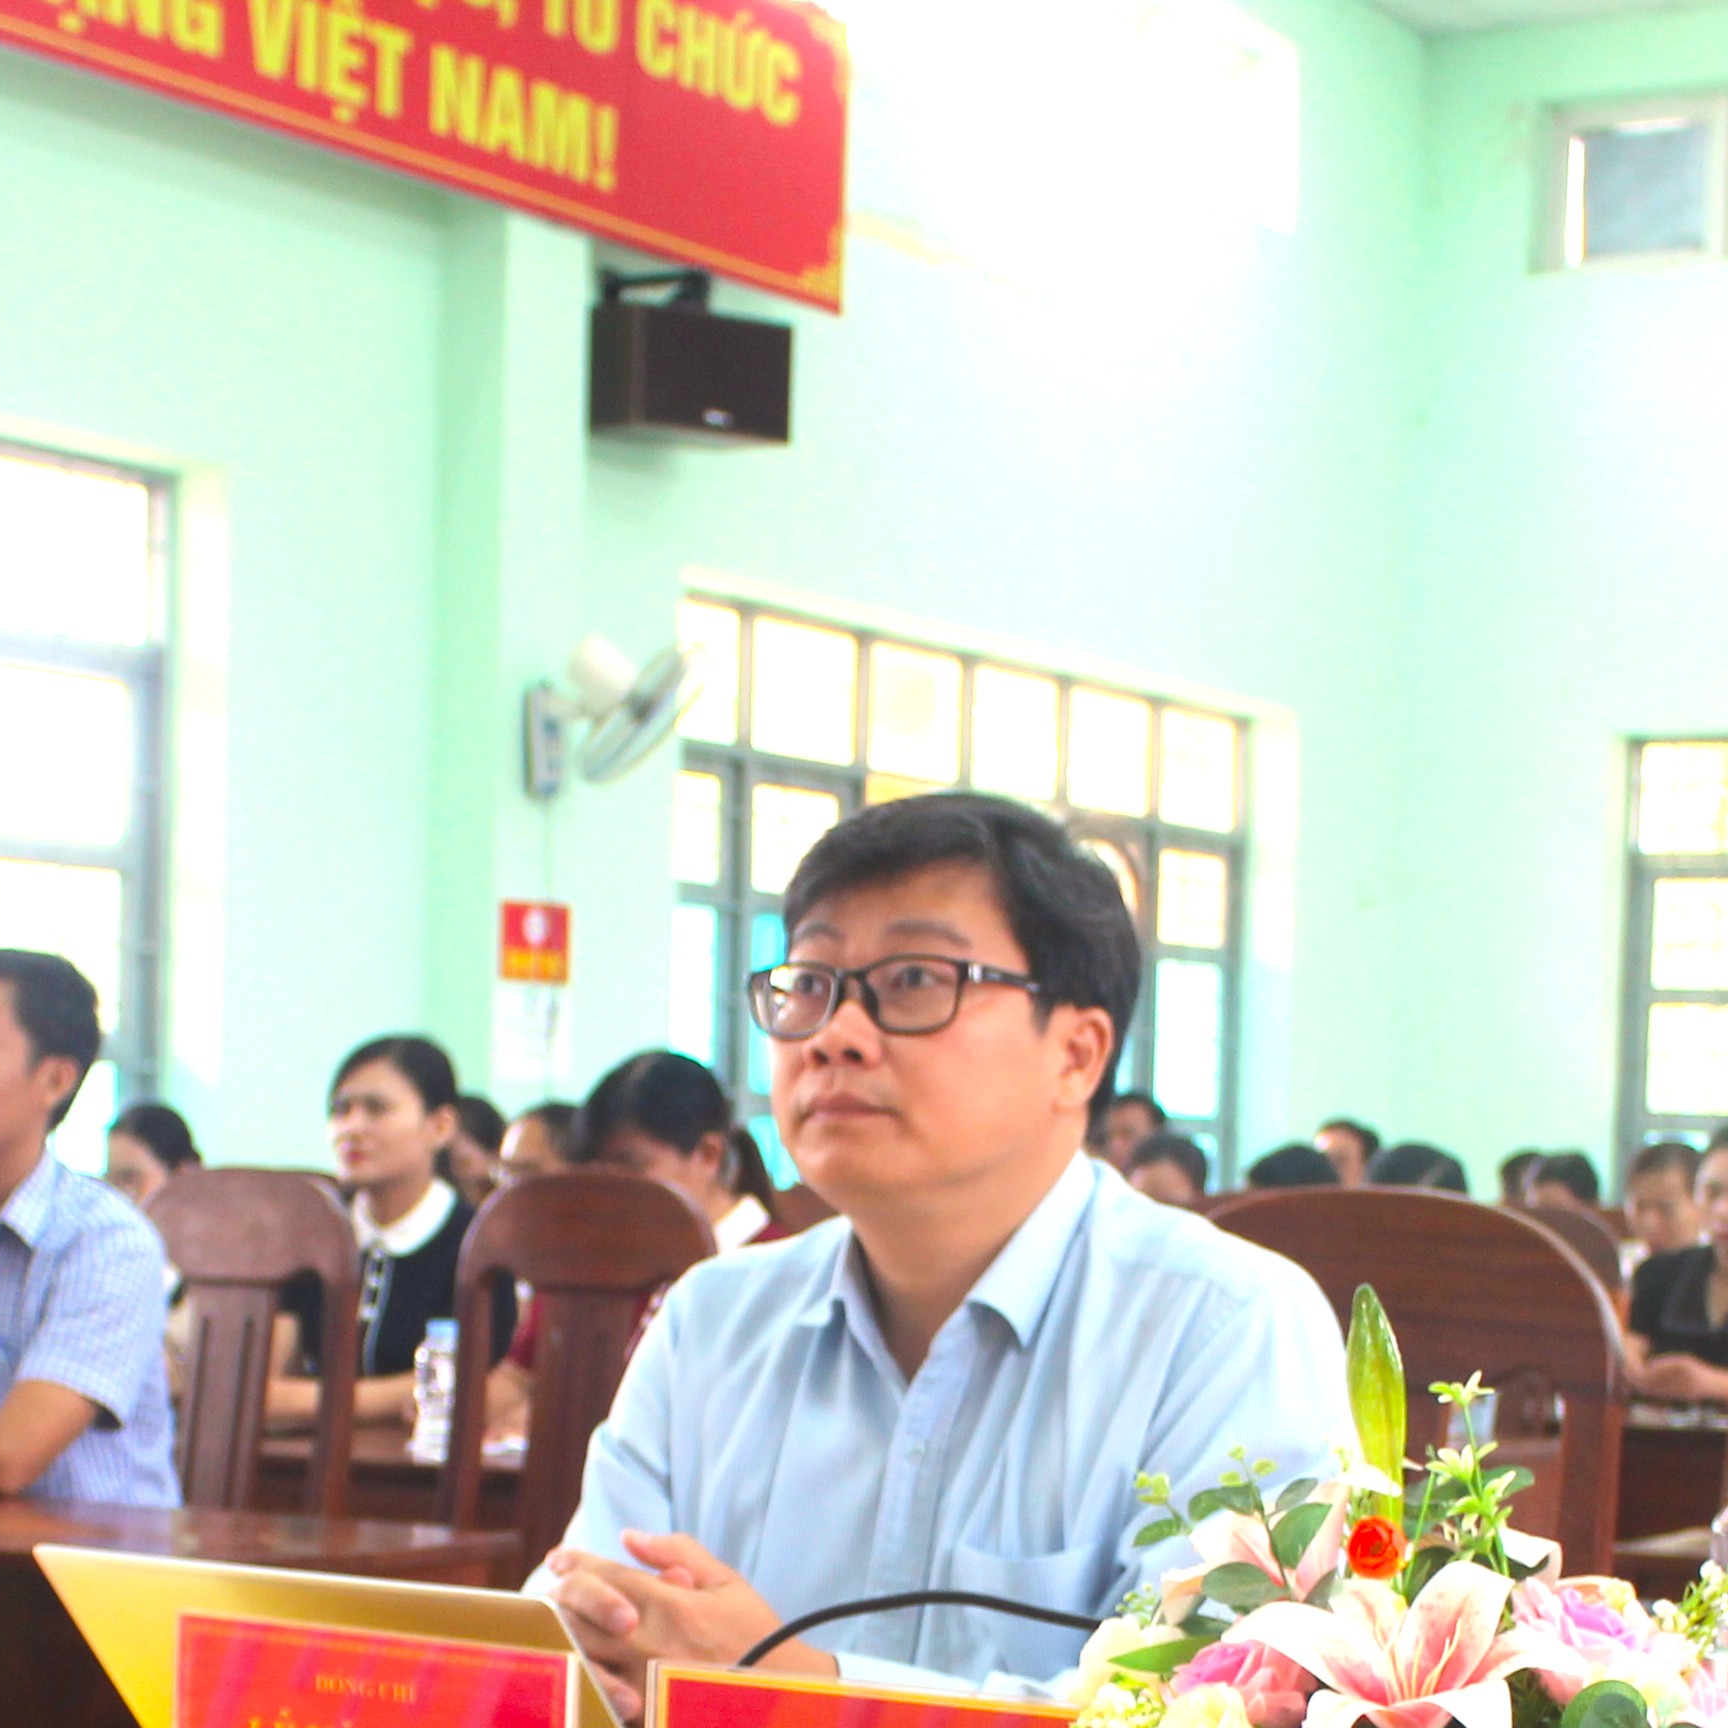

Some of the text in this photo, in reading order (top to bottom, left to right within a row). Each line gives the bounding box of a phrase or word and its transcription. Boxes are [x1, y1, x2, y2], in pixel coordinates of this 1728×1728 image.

[247, 0, 415, 122] VIỆT
[428, 41, 620, 192] NAM!
[635, 0, 801, 127] CHỨC
